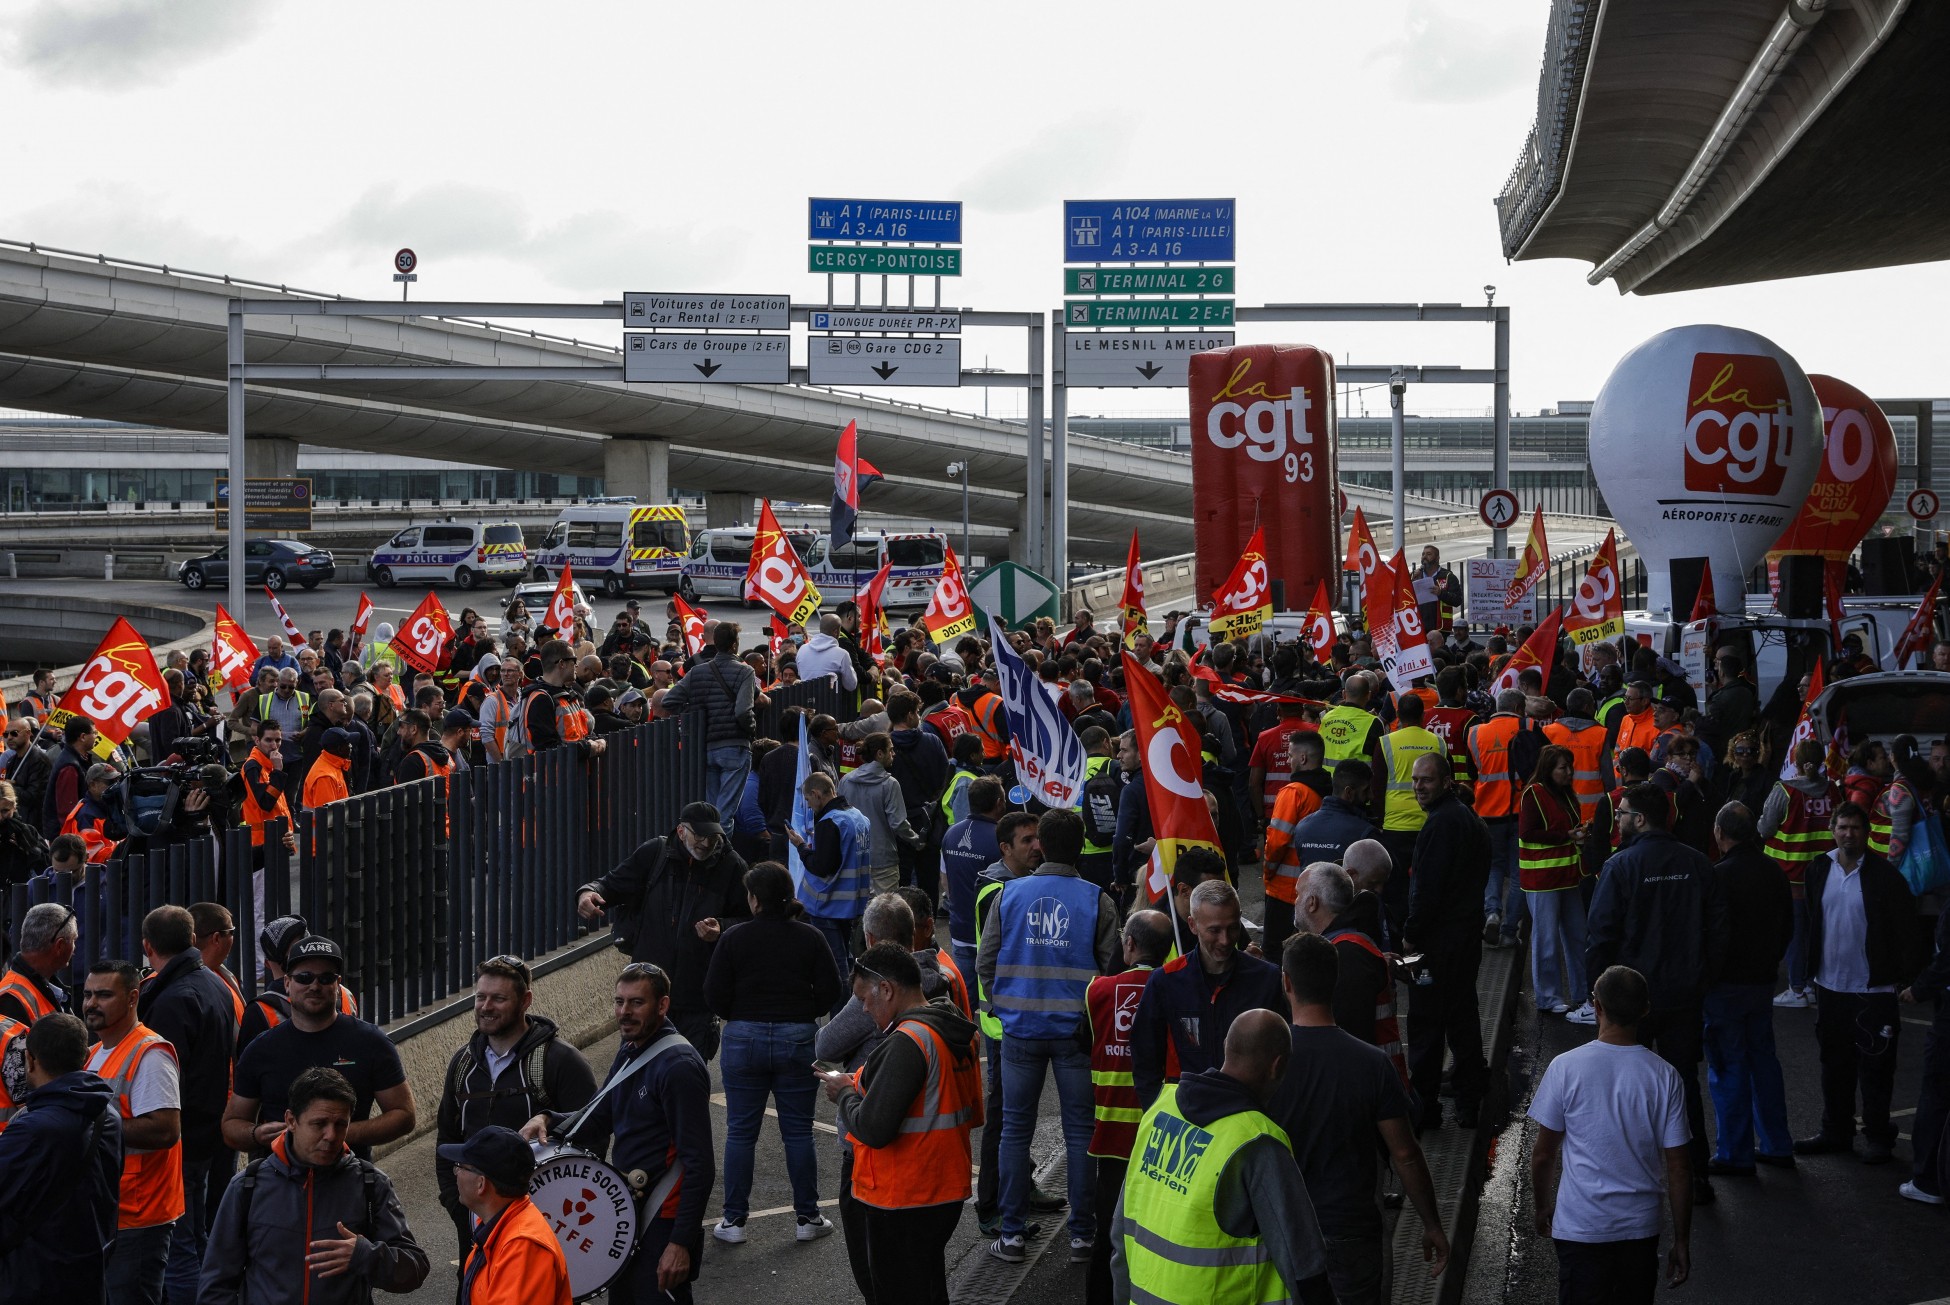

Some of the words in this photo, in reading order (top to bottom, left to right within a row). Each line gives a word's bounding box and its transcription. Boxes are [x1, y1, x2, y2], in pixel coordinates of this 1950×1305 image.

[840, 205, 851, 219] A
[855, 205, 862, 219] 1
[869, 207, 957, 222] (PARIS-LILLE)
[1154, 208, 1199, 221] (MARNE
[840, 222, 851, 236] A
[891, 223, 907, 237] 16
[1112, 225, 1122, 238] A
[1128, 225, 1134, 238] 1
[1141, 225, 1231, 240] (PARIS-LILLE)
[1112, 243, 1122, 257] A
[1165, 243, 1182, 257] 16
[399, 256, 412, 267] 50
[815, 252, 956, 269] CERGY-PONTOISE
[1103, 274, 1187, 289] TERMINAL
[1197, 274, 1207, 288] 2
[1212, 274, 1223, 288] G
[650, 298, 704, 311] Voitures
[711, 298, 725, 311] de
[731, 299, 785, 311] Location
[650, 312, 673, 325] Car
[678, 312, 720, 324] Rental
[1096, 306, 1179, 321] TERMINAL
[1189, 306, 1199, 320] 2
[1203, 306, 1231, 320] E-F
[833, 317, 874, 329] LONGUE
[917, 317, 957, 330] PR-PX
[650, 339, 678, 352] Cars
[683, 339, 698, 352] de
[703, 340, 747, 354] Groupe
[865, 342, 896, 355] Gare
[904, 342, 933, 354] CDG
[935, 342, 944, 355] 2
[1075, 339, 1092, 350] LE
[1099, 339, 1156, 350] MESNIL
[1165, 339, 1224, 350] AMELOT
[1207, 386, 1313, 462] cgt
[1685, 399, 1793, 483] cgt
[1284, 452, 1314, 483] 93
[1820, 496, 1849, 510] CDG
[1661, 508, 1737, 525] AÉROPORTS
[1740, 512, 1756, 525] DE
[1757, 514, 1784, 527] PARIS
[406, 554, 443, 564] POLICE
[568, 556, 593, 565] POLICE
[704, 566, 732, 576] POLICE
[822, 574, 853, 584] POLICE
[76, 655, 161, 728] cgt
[1325, 719, 1357, 733] ORGANISATION
[1331, 726, 1347, 738] cgt
[843, 744, 855, 757] cgt
[1805, 795, 1831, 816] cgt
[1089, 793, 1117, 833] NIKE
[959, 850, 985, 861] AÉROPORT
[1644, 874, 1682, 884] AIRFRANCE
[300, 942, 332, 954] VANS
[1026, 937, 1069, 947] TRANSPORT
[1105, 1044, 1132, 1057] ROIS
[528, 1164, 591, 1196] ENTRALE
[1139, 1160, 1188, 1196] Aérien
[591, 1169, 629, 1217] SOCIAL
[608, 1219, 630, 1261] CLUB
